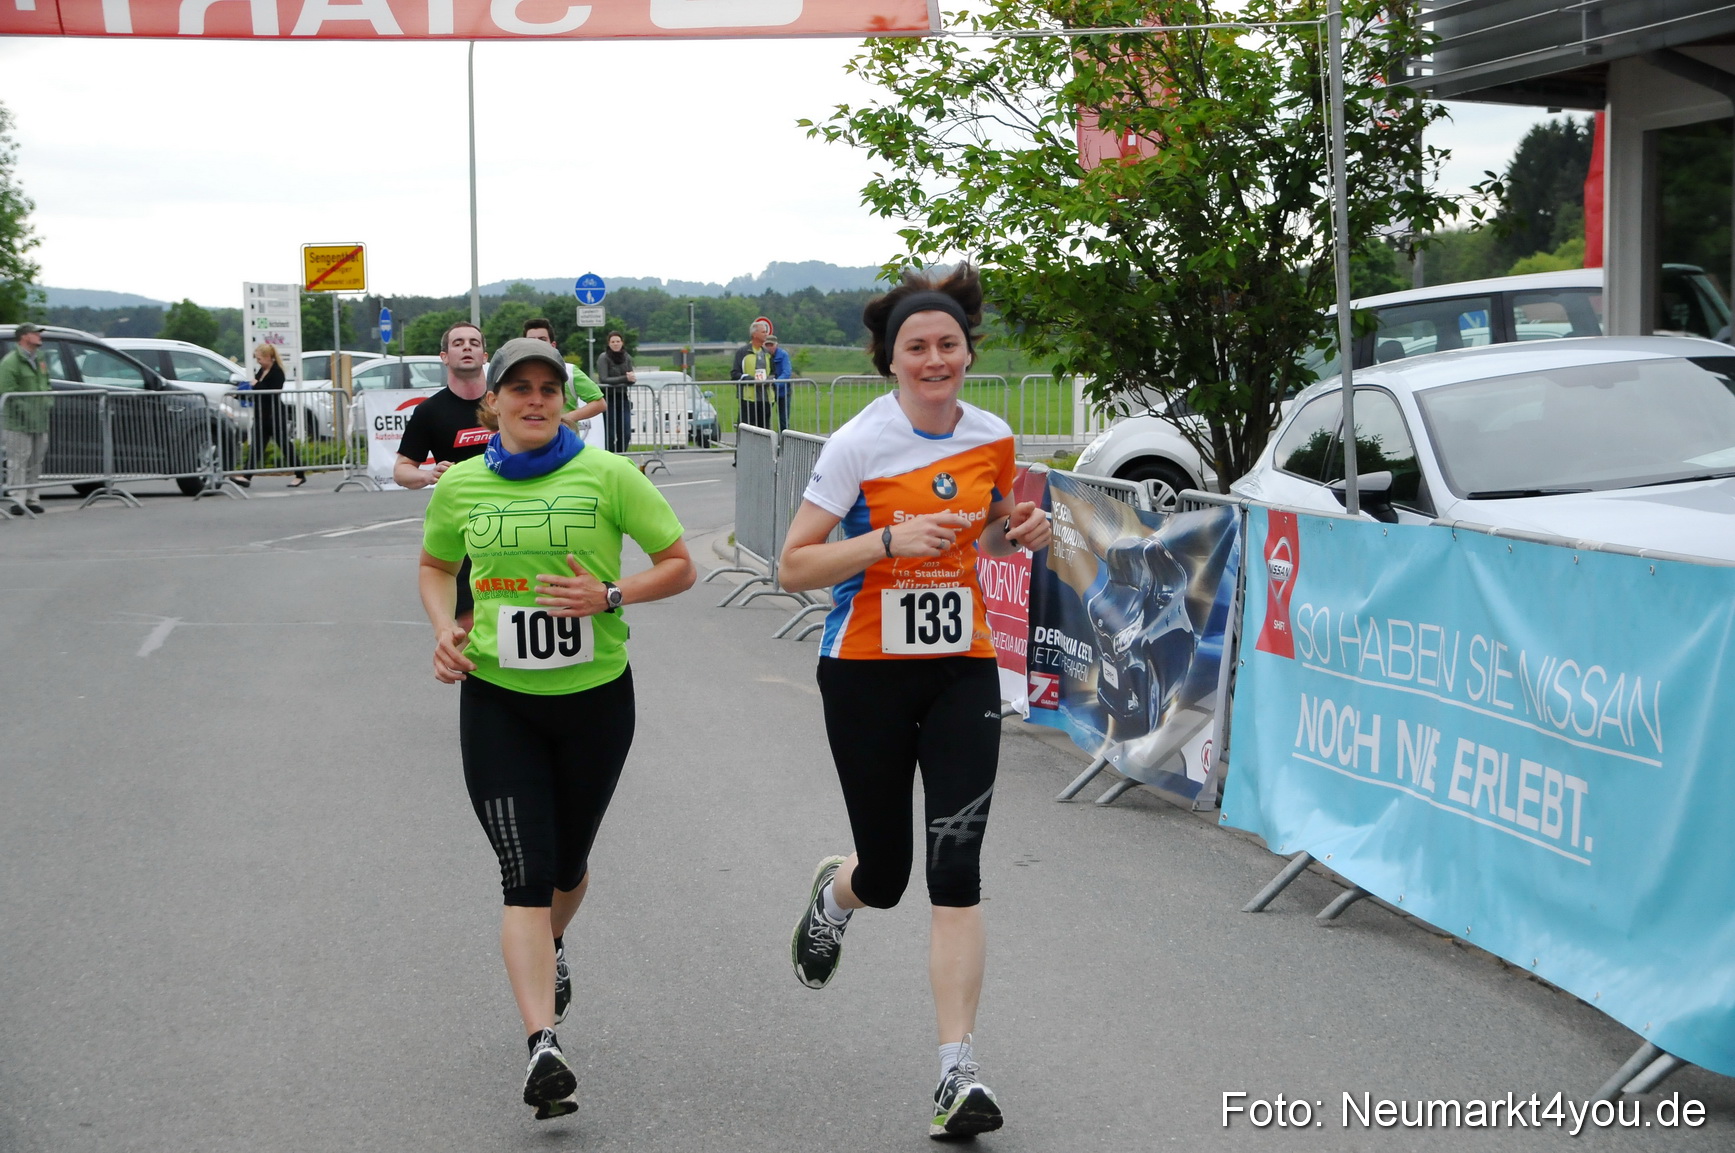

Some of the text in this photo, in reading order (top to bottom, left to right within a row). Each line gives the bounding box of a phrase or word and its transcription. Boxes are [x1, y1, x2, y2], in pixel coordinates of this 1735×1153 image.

[915, 568, 961, 578] Stadtlauf
[1268, 562, 1291, 578] NISSAN
[475, 577, 530, 593] MERZ
[900, 591, 963, 645] 133
[511, 610, 582, 660] 109
[1034, 626, 1060, 646] DER
[1028, 675, 1052, 703] 7
[1297, 602, 1663, 754] SO HABEN SIE NISSAN
[1294, 692, 1381, 773] NOCH
[1448, 737, 1594, 854] ERLEBT.
